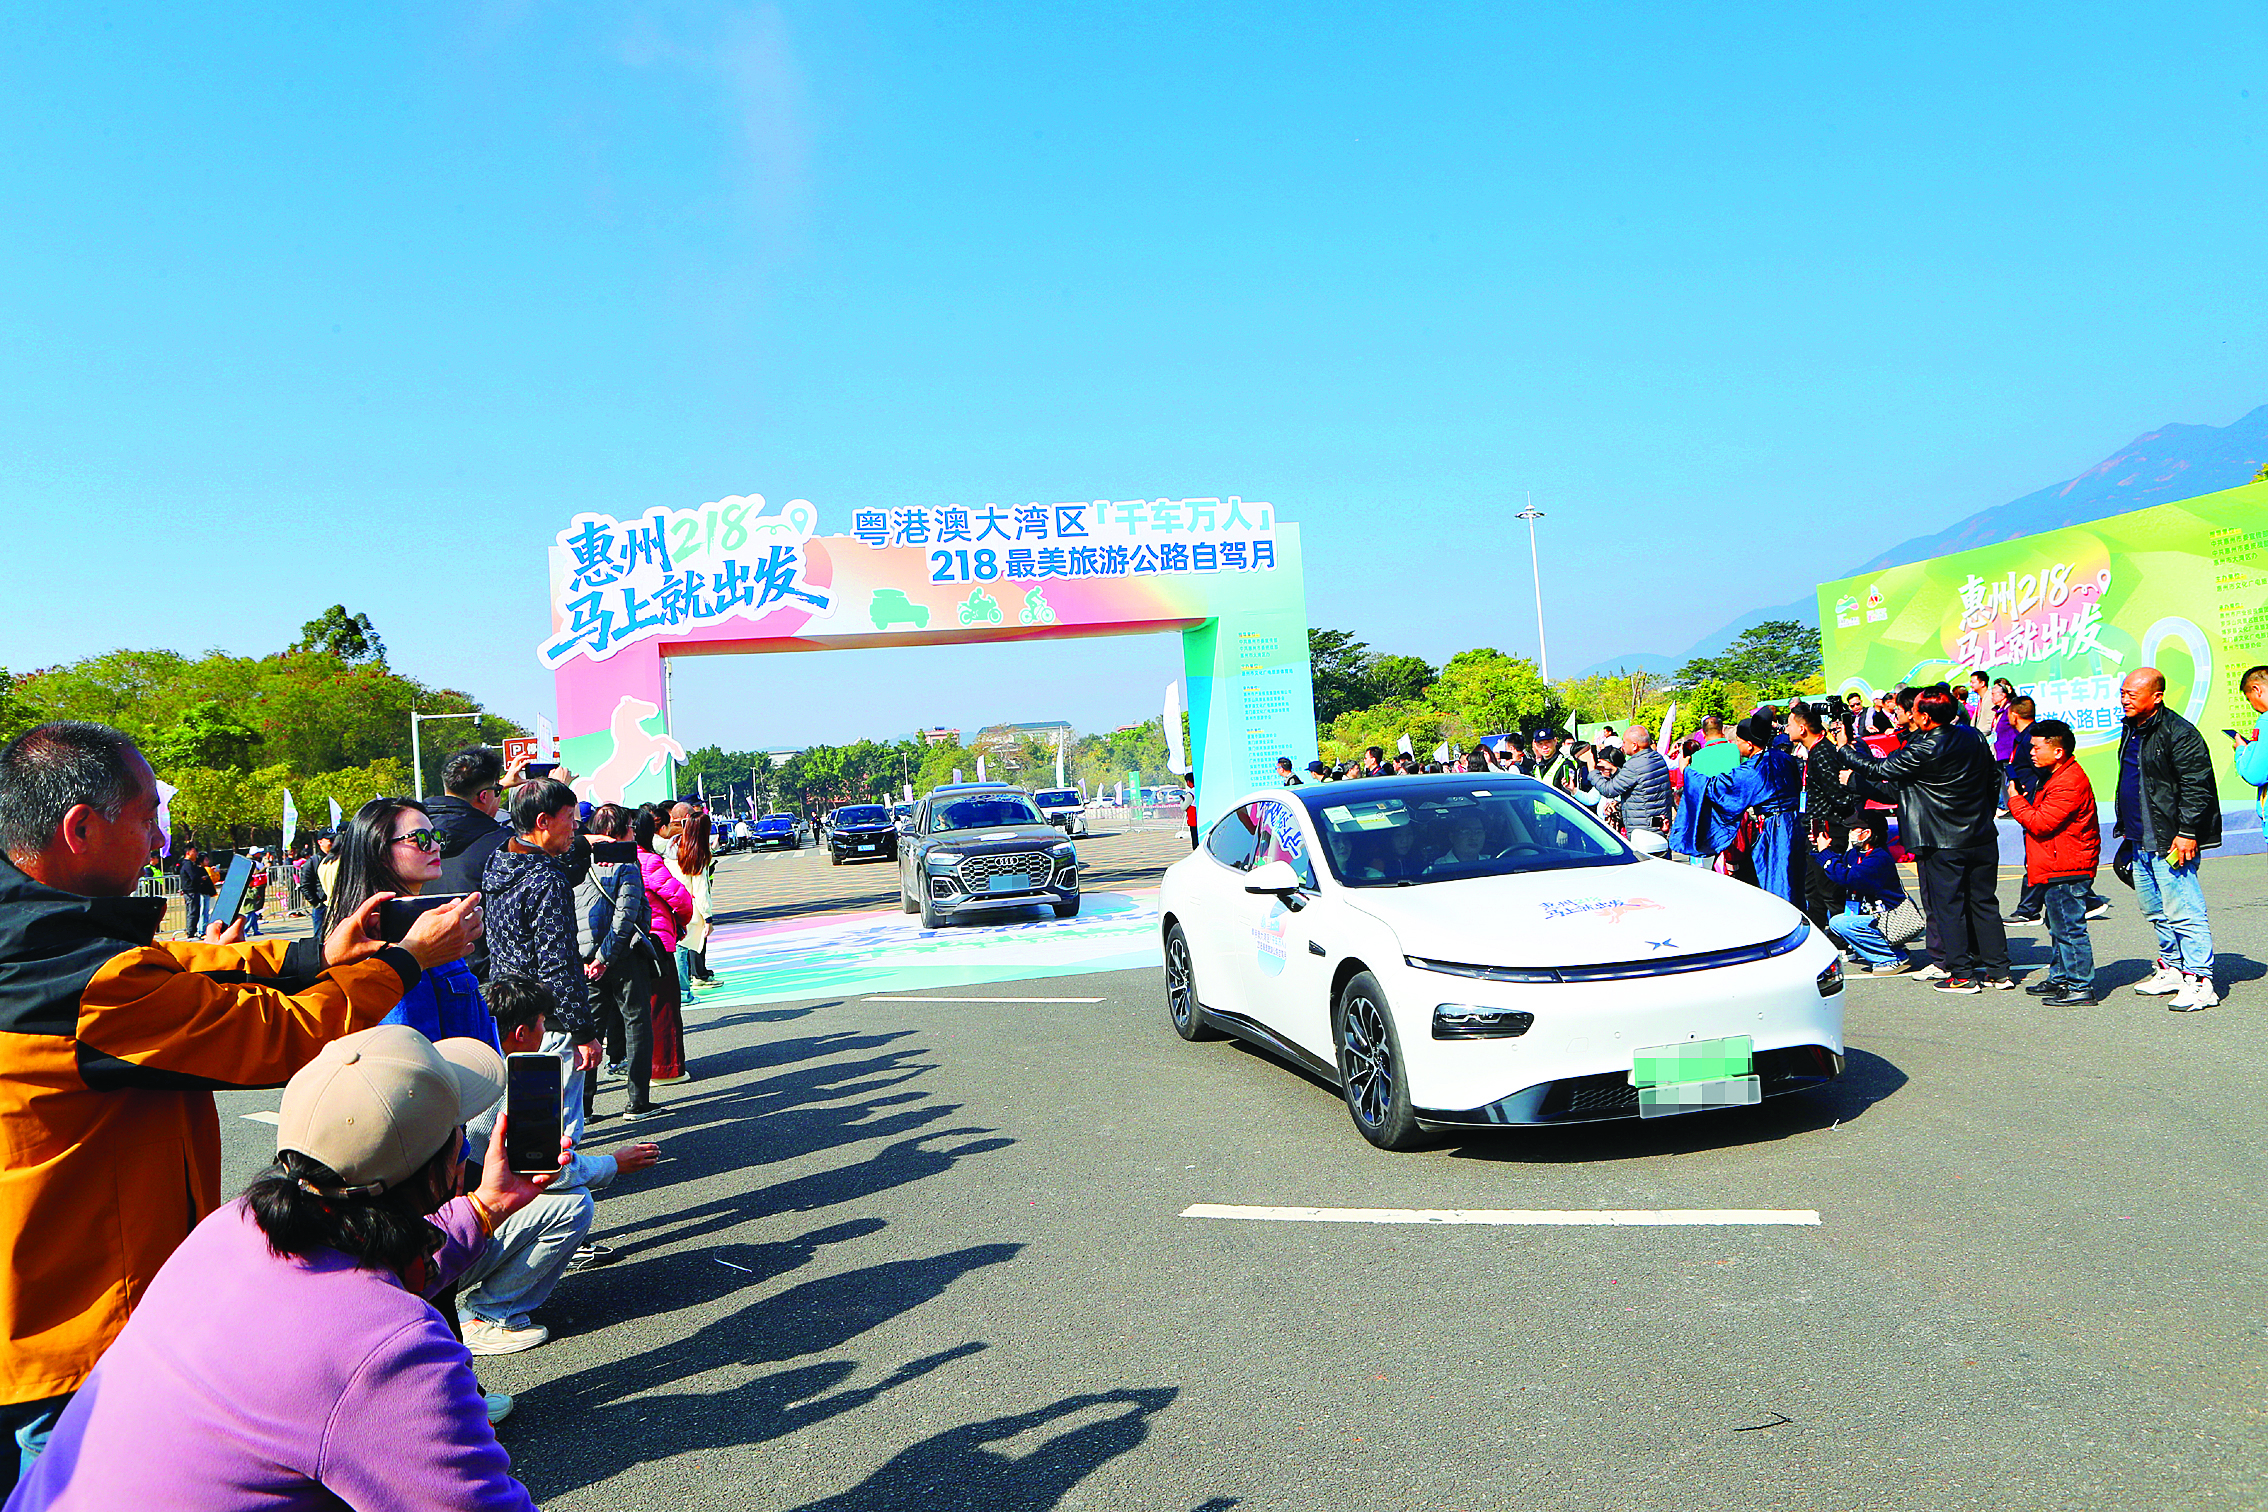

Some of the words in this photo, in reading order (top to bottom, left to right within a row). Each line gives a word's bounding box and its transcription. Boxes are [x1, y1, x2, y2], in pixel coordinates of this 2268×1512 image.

[566, 503, 756, 592] 惠州218
[853, 499, 1272, 546] 粤港澳大湾区「千车万人」
[547, 545, 830, 661] 马上就出发
[1957, 562, 2076, 632] 惠州218
[1944, 602, 2124, 682] 马上就出发
